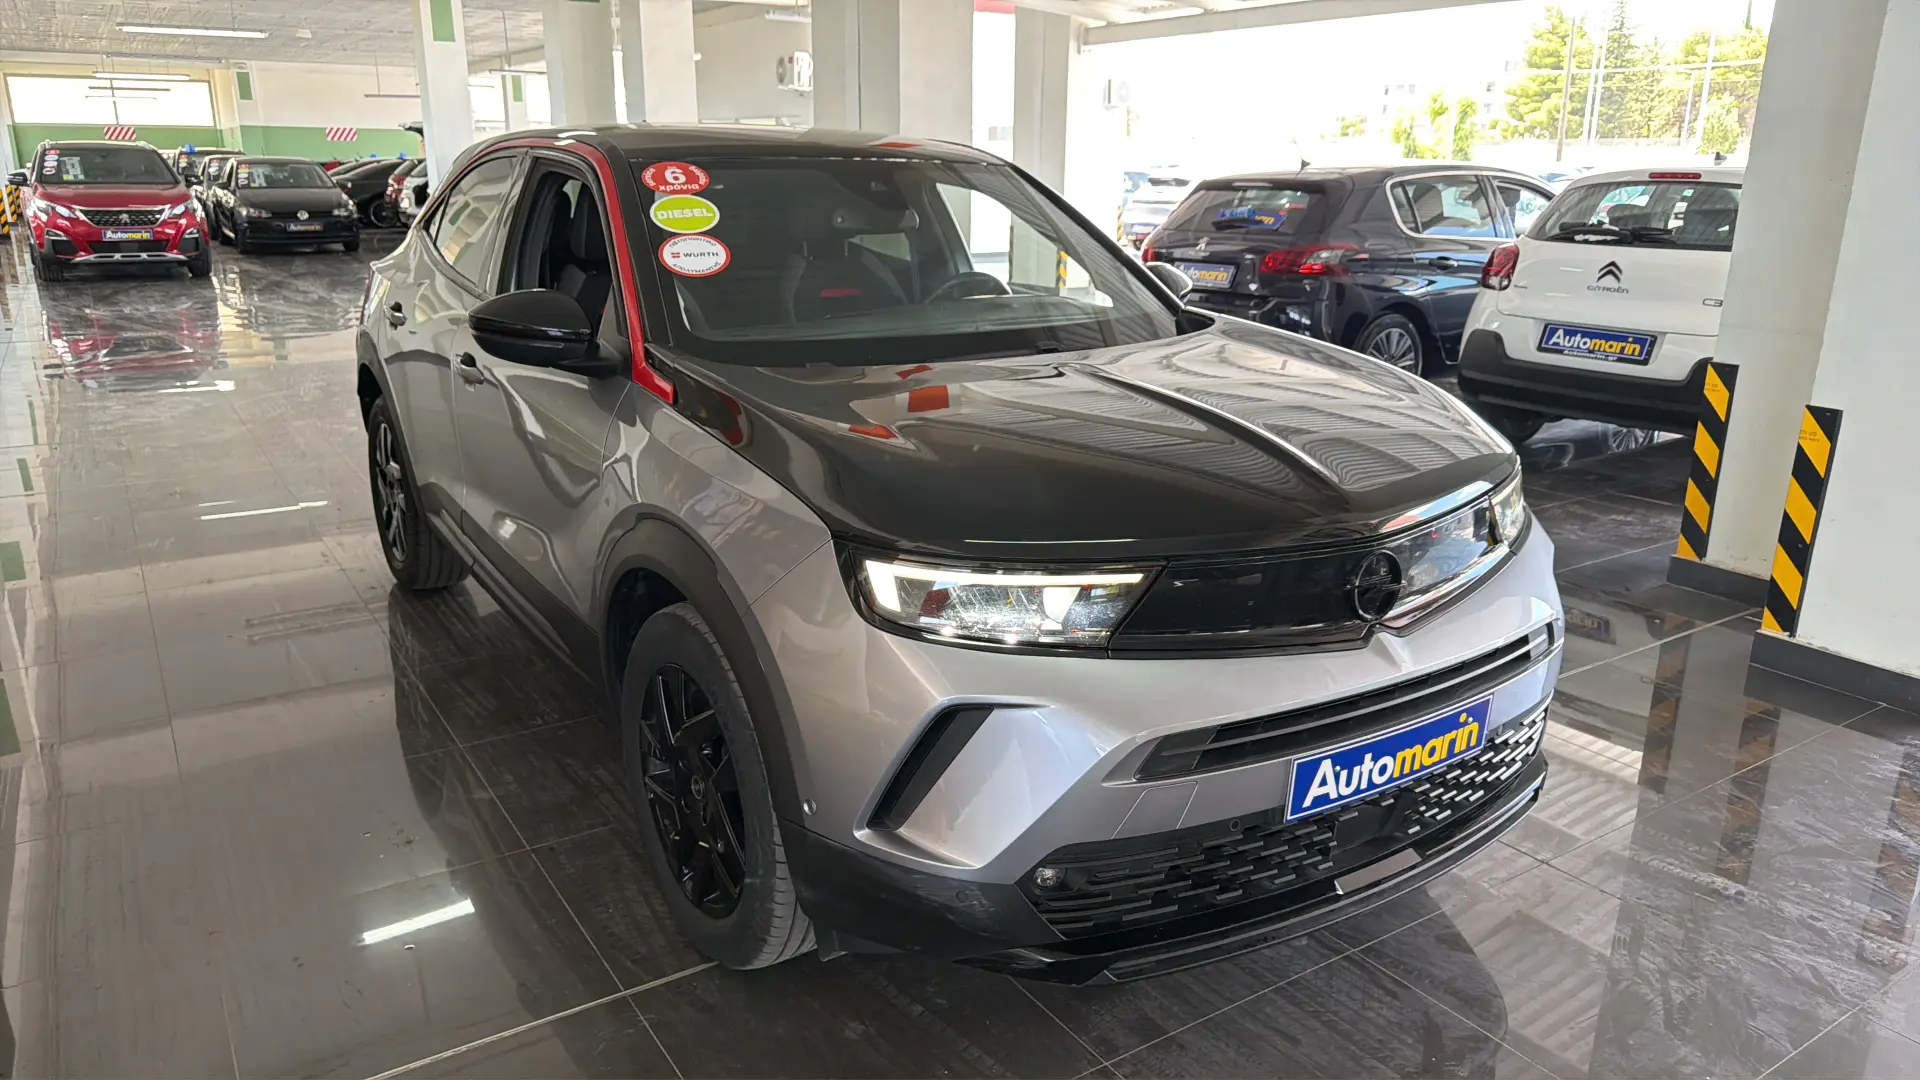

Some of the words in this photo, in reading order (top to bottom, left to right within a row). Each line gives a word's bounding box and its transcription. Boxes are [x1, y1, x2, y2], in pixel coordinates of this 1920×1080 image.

[664, 168, 686, 184] 6
[658, 182, 700, 192] χρόνια
[656, 208, 714, 220] DIESEL
[105, 230, 150, 239] Automarin
[1702, 298, 1723, 307] C3
[1548, 328, 1641, 357] Automarin
[1301, 712, 1479, 809] Automarin
